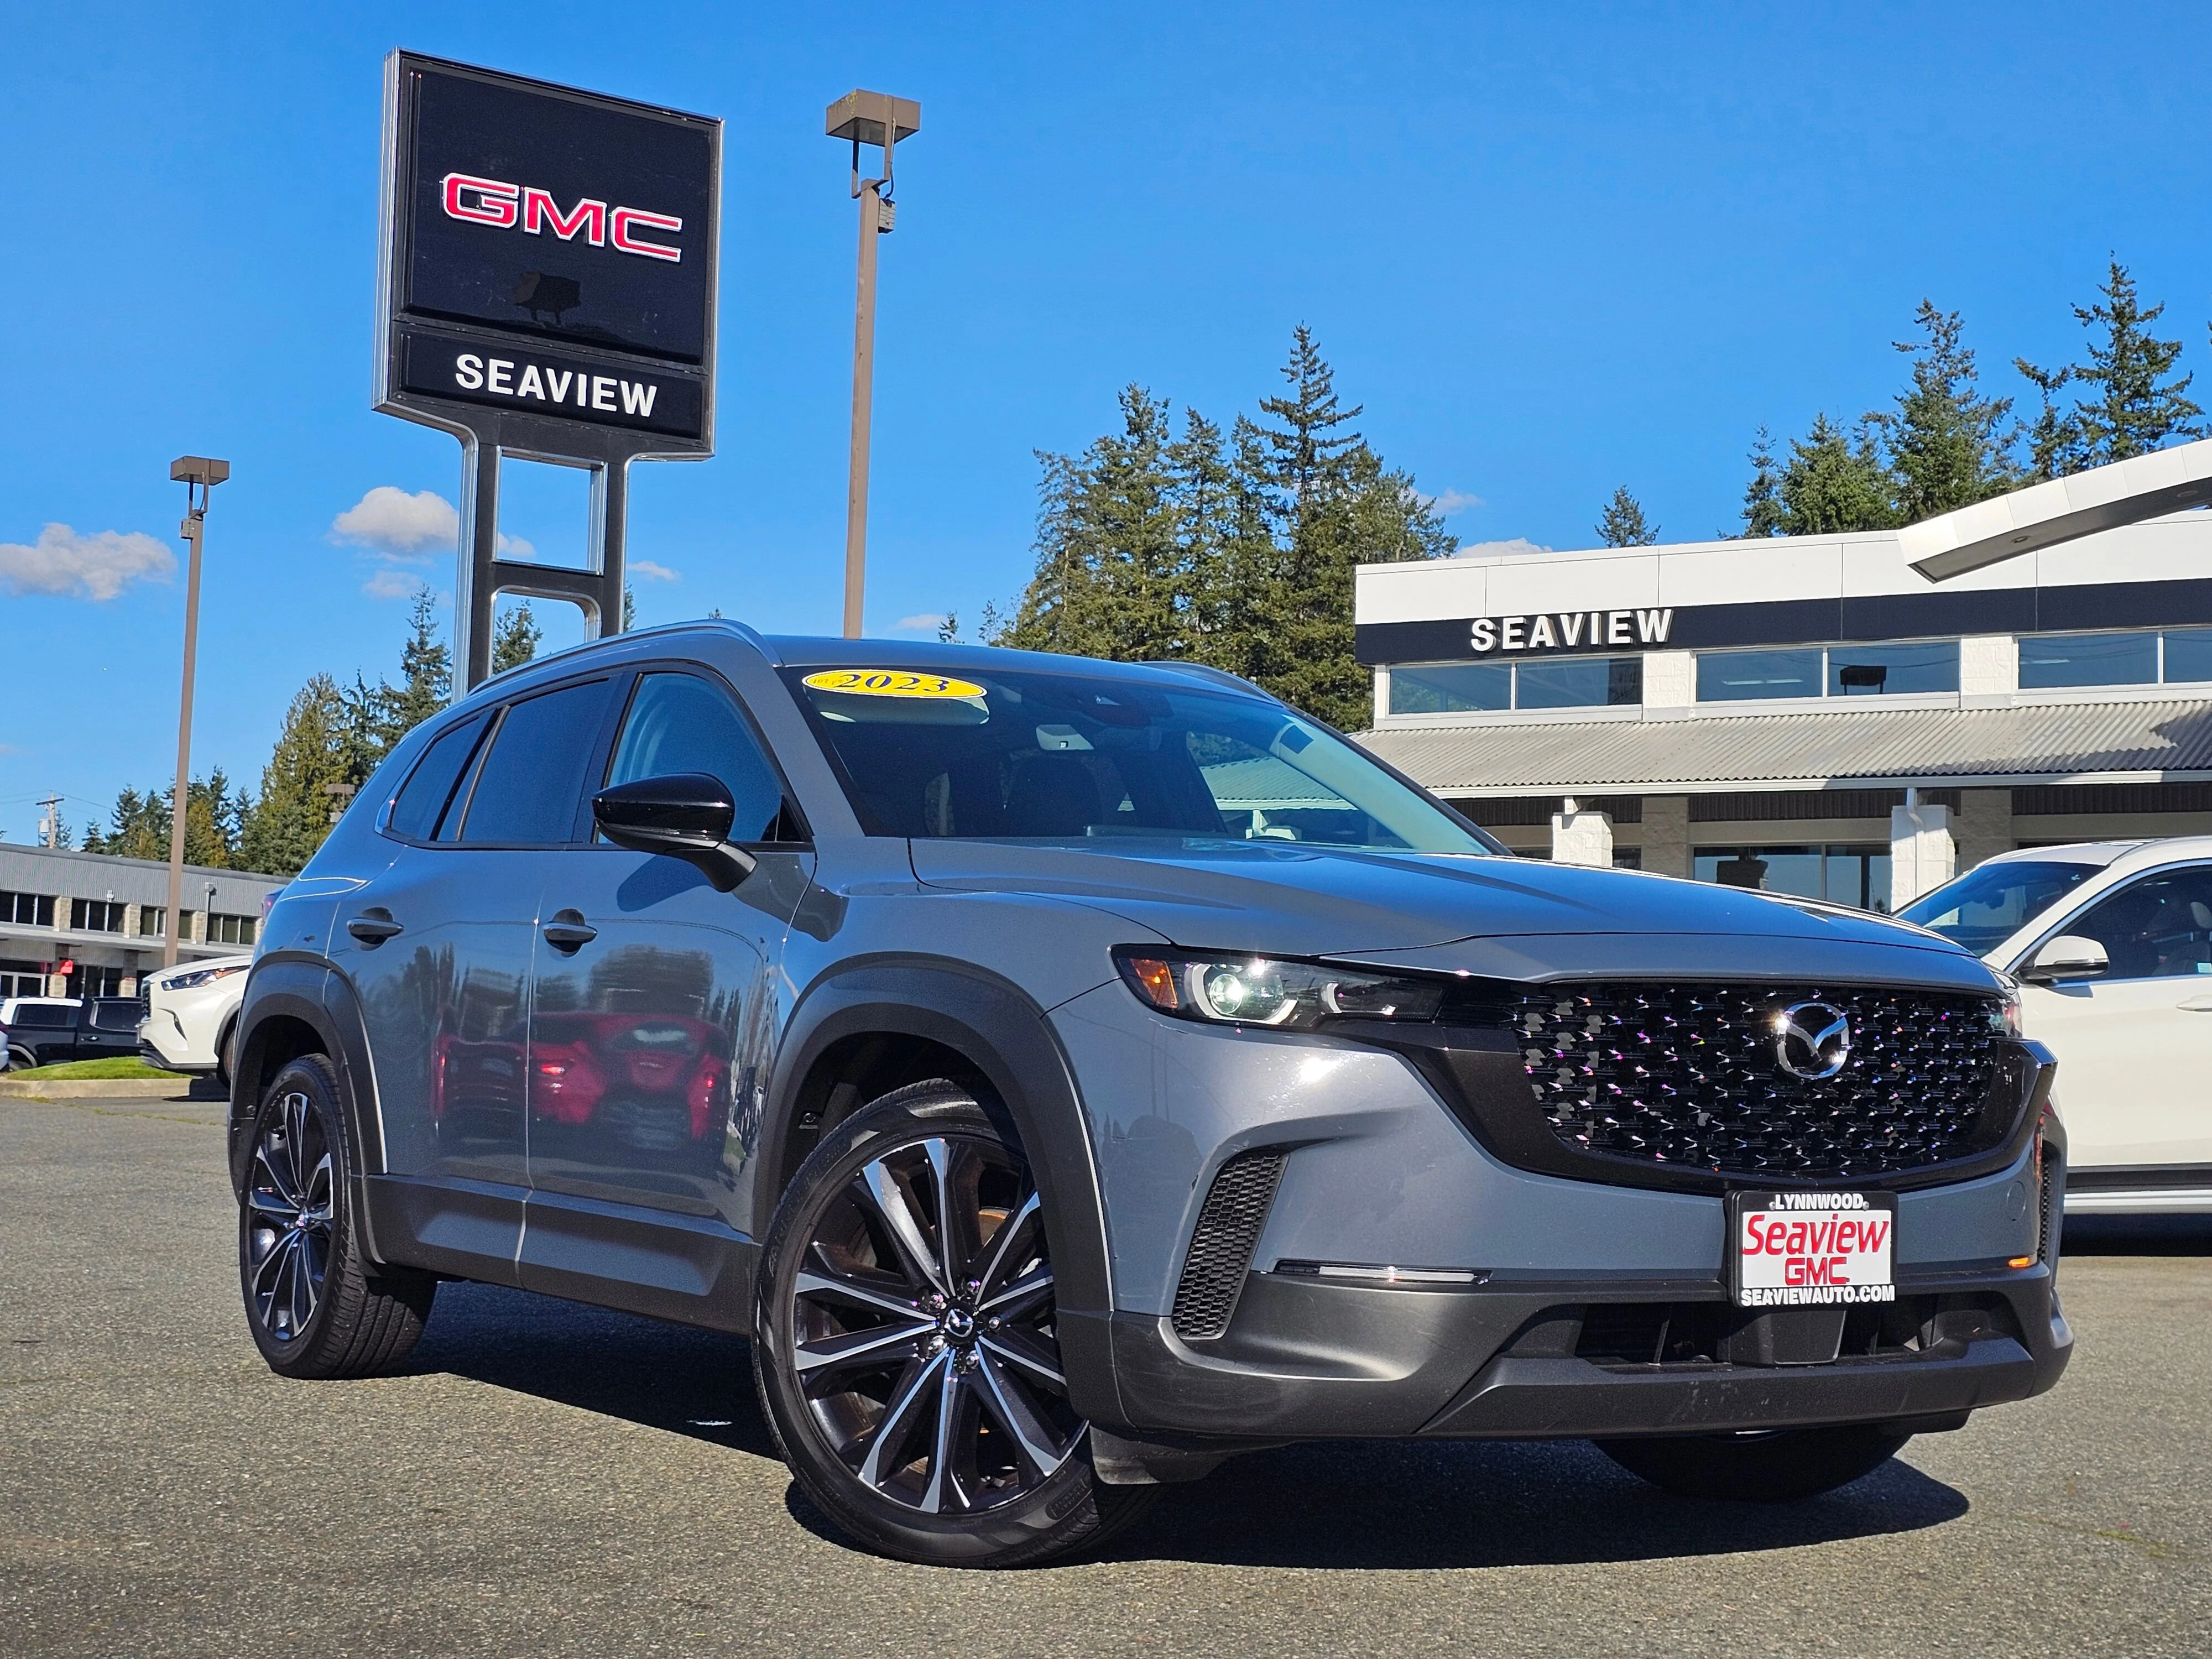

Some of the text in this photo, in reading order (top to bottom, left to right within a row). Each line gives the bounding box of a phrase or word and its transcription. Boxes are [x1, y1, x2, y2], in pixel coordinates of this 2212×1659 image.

[444, 173, 682, 262] GMC
[456, 354, 657, 418] SEAVIEW
[1471, 609, 1673, 651] SEAVIEW
[834, 674, 949, 692] 2023
[1775, 1193, 1863, 1210] LYNNWOOD
[1742, 1214, 1889, 1255] Seaview
[1785, 1256, 1848, 1285] GMC
[1741, 1285, 1895, 1307] SEAVIEWAUTO.COM
